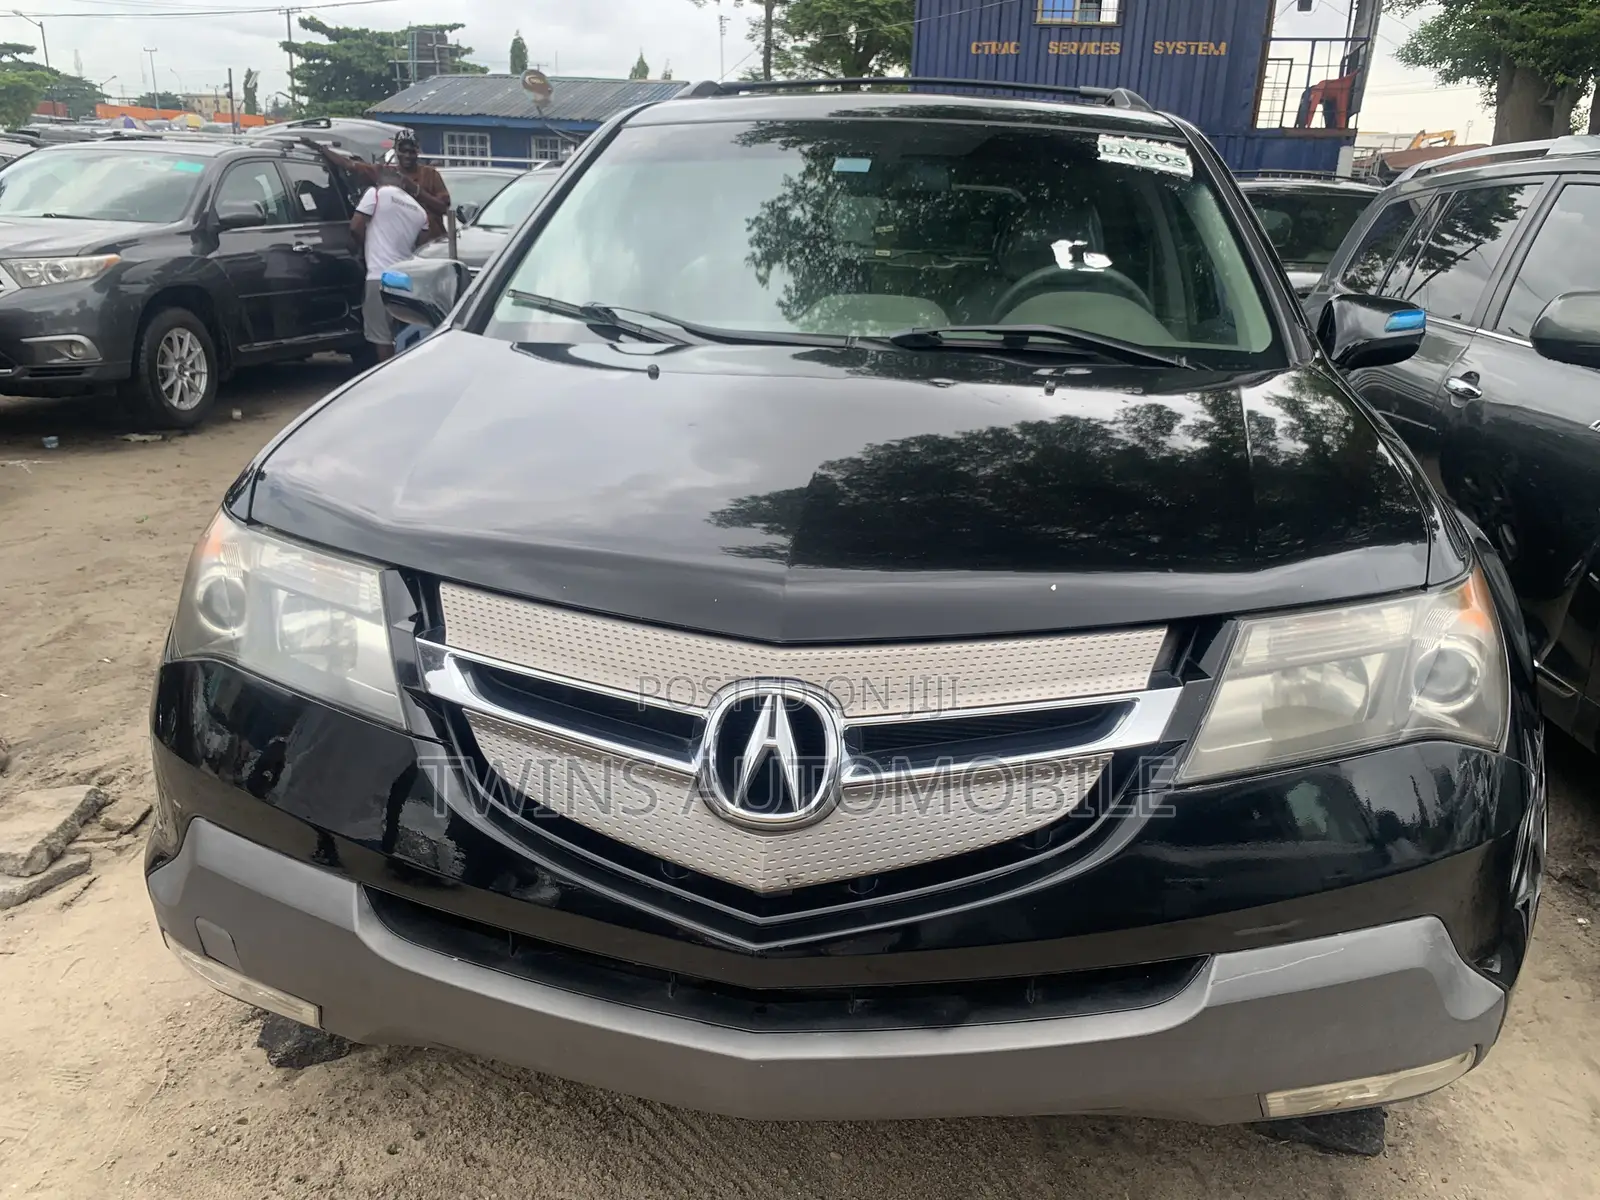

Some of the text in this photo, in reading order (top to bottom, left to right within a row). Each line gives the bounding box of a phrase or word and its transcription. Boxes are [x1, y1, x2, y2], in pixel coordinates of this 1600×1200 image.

[1048, 41, 1120, 55] SERVICES
[1153, 41, 1227, 55] SYSTEM
[1101, 144, 1186, 168] LAGOS
